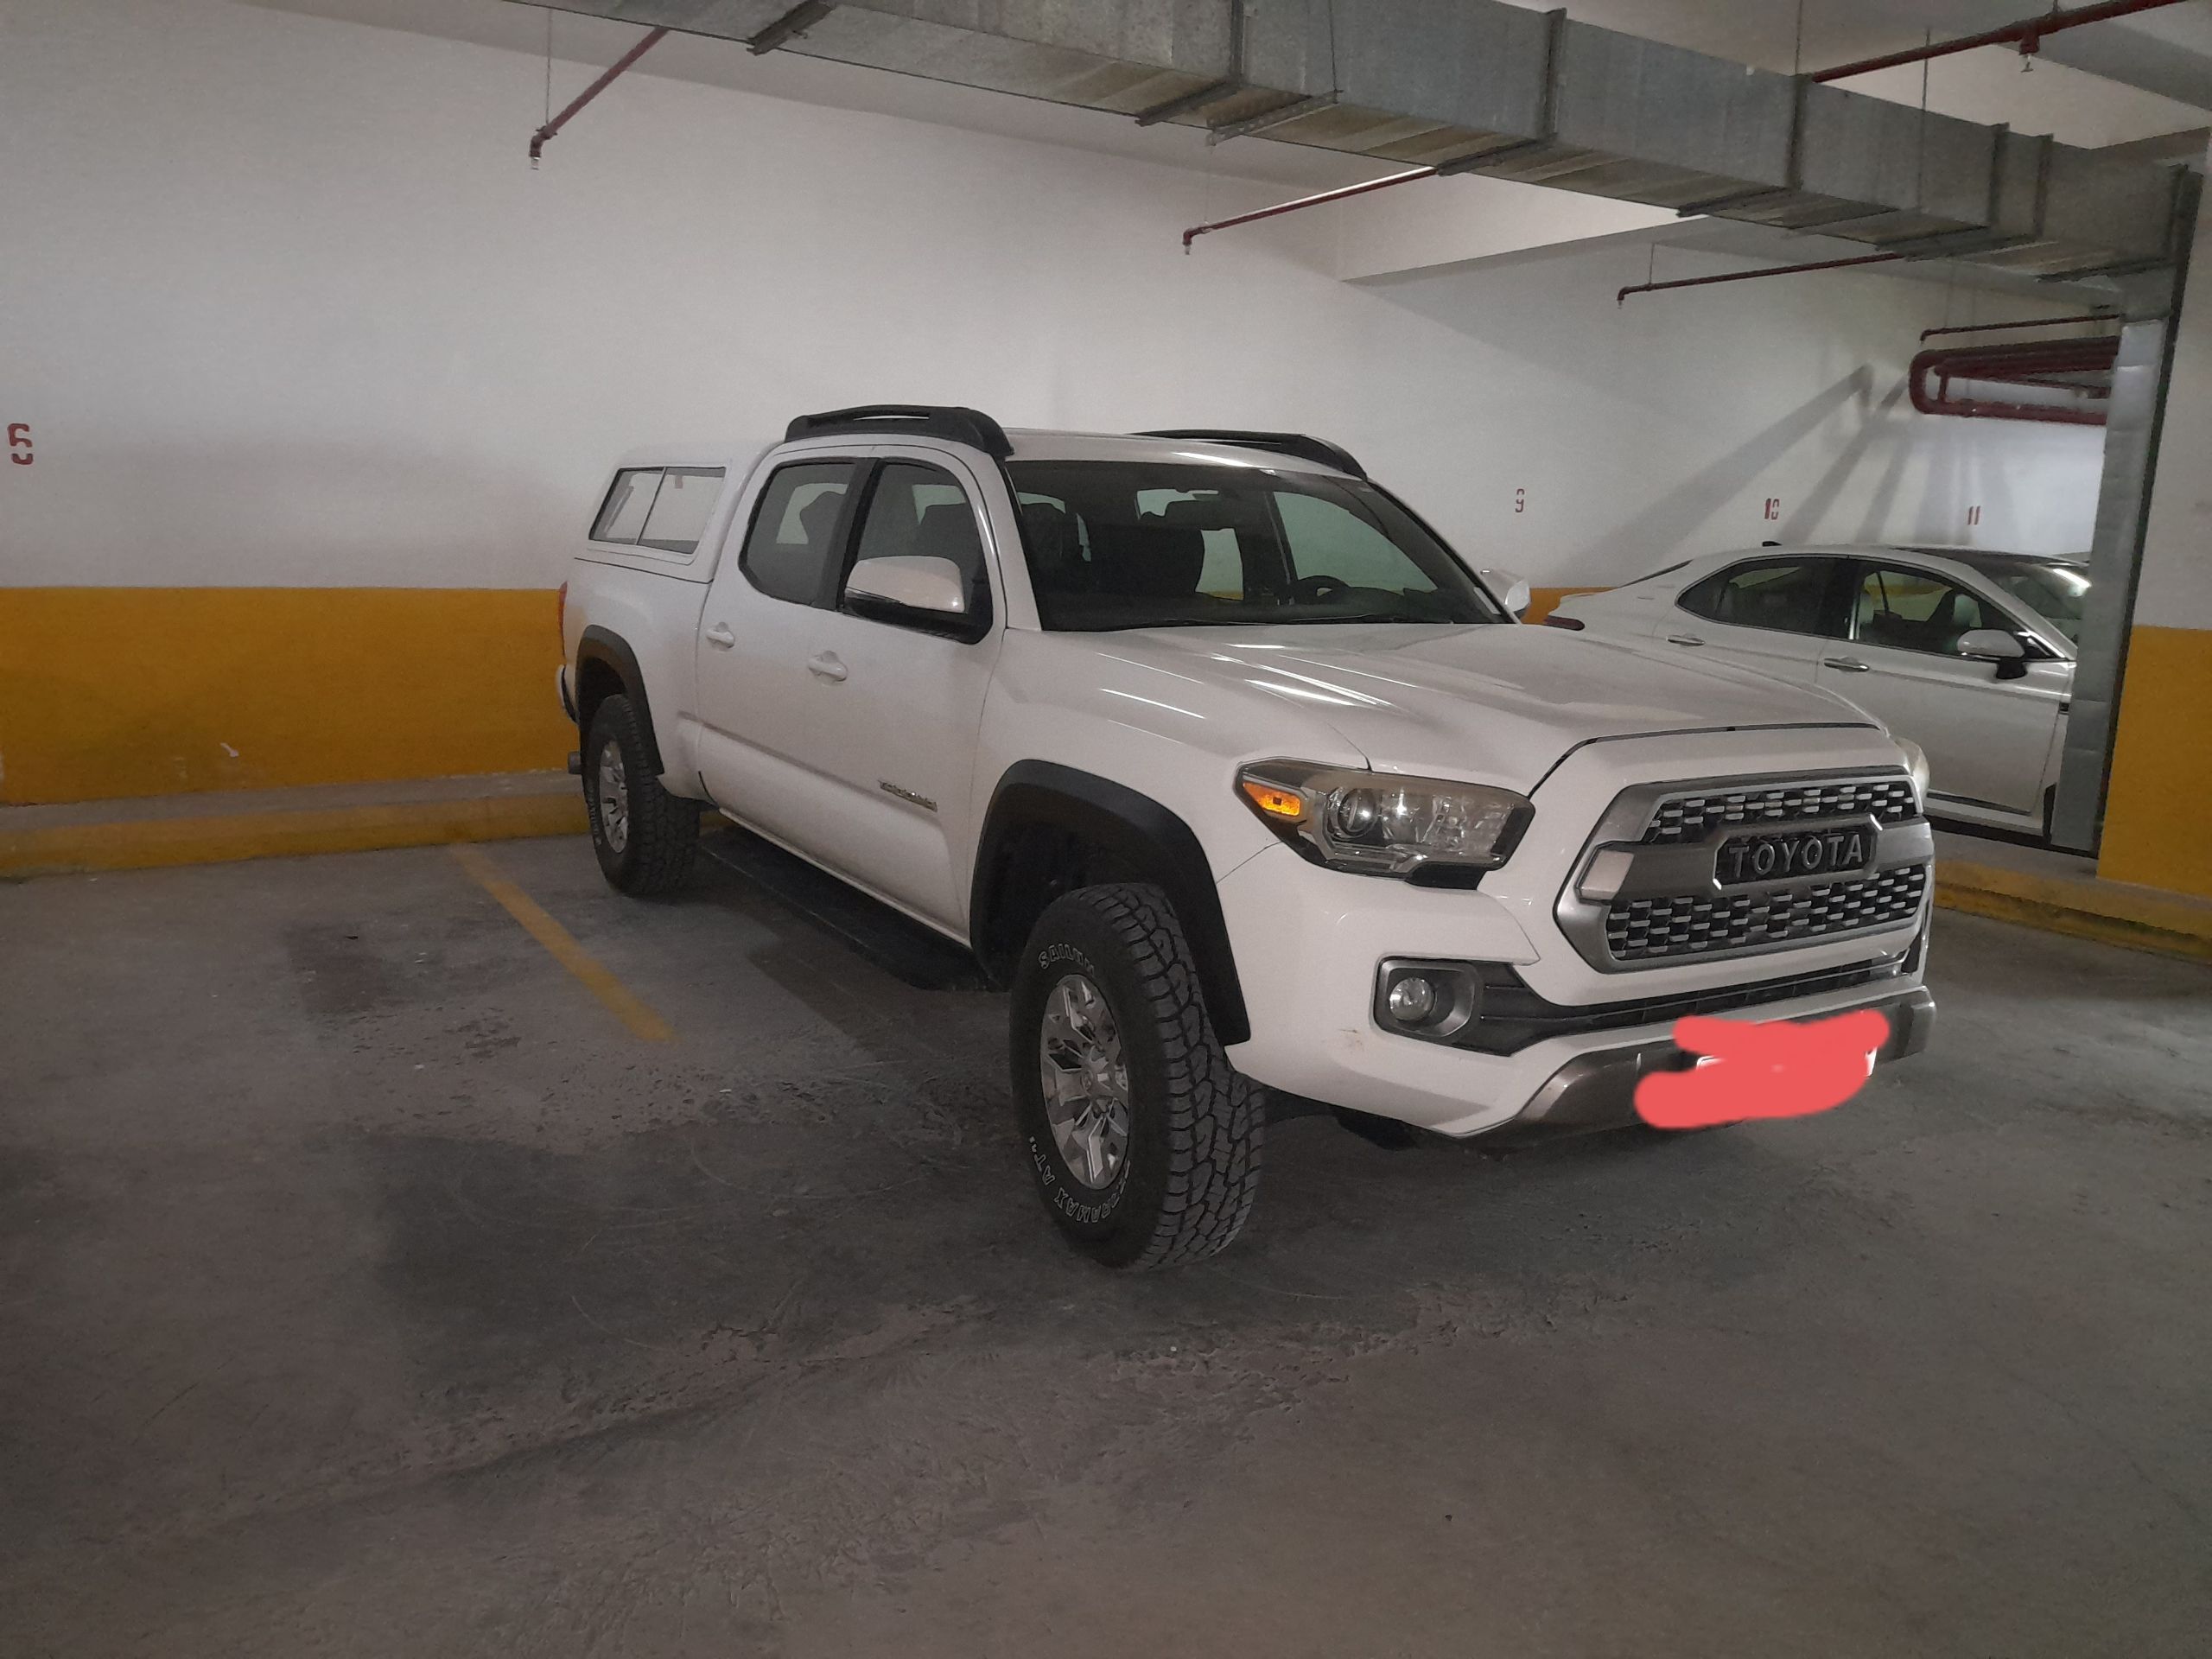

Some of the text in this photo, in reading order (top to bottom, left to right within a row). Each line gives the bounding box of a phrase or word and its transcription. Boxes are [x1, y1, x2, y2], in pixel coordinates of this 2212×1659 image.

[1515, 488, 1525, 513] 9
[1764, 498, 1780, 520] 10
[1967, 505, 1981, 525] 11
[1727, 834, 1863, 879] TOYOTA
